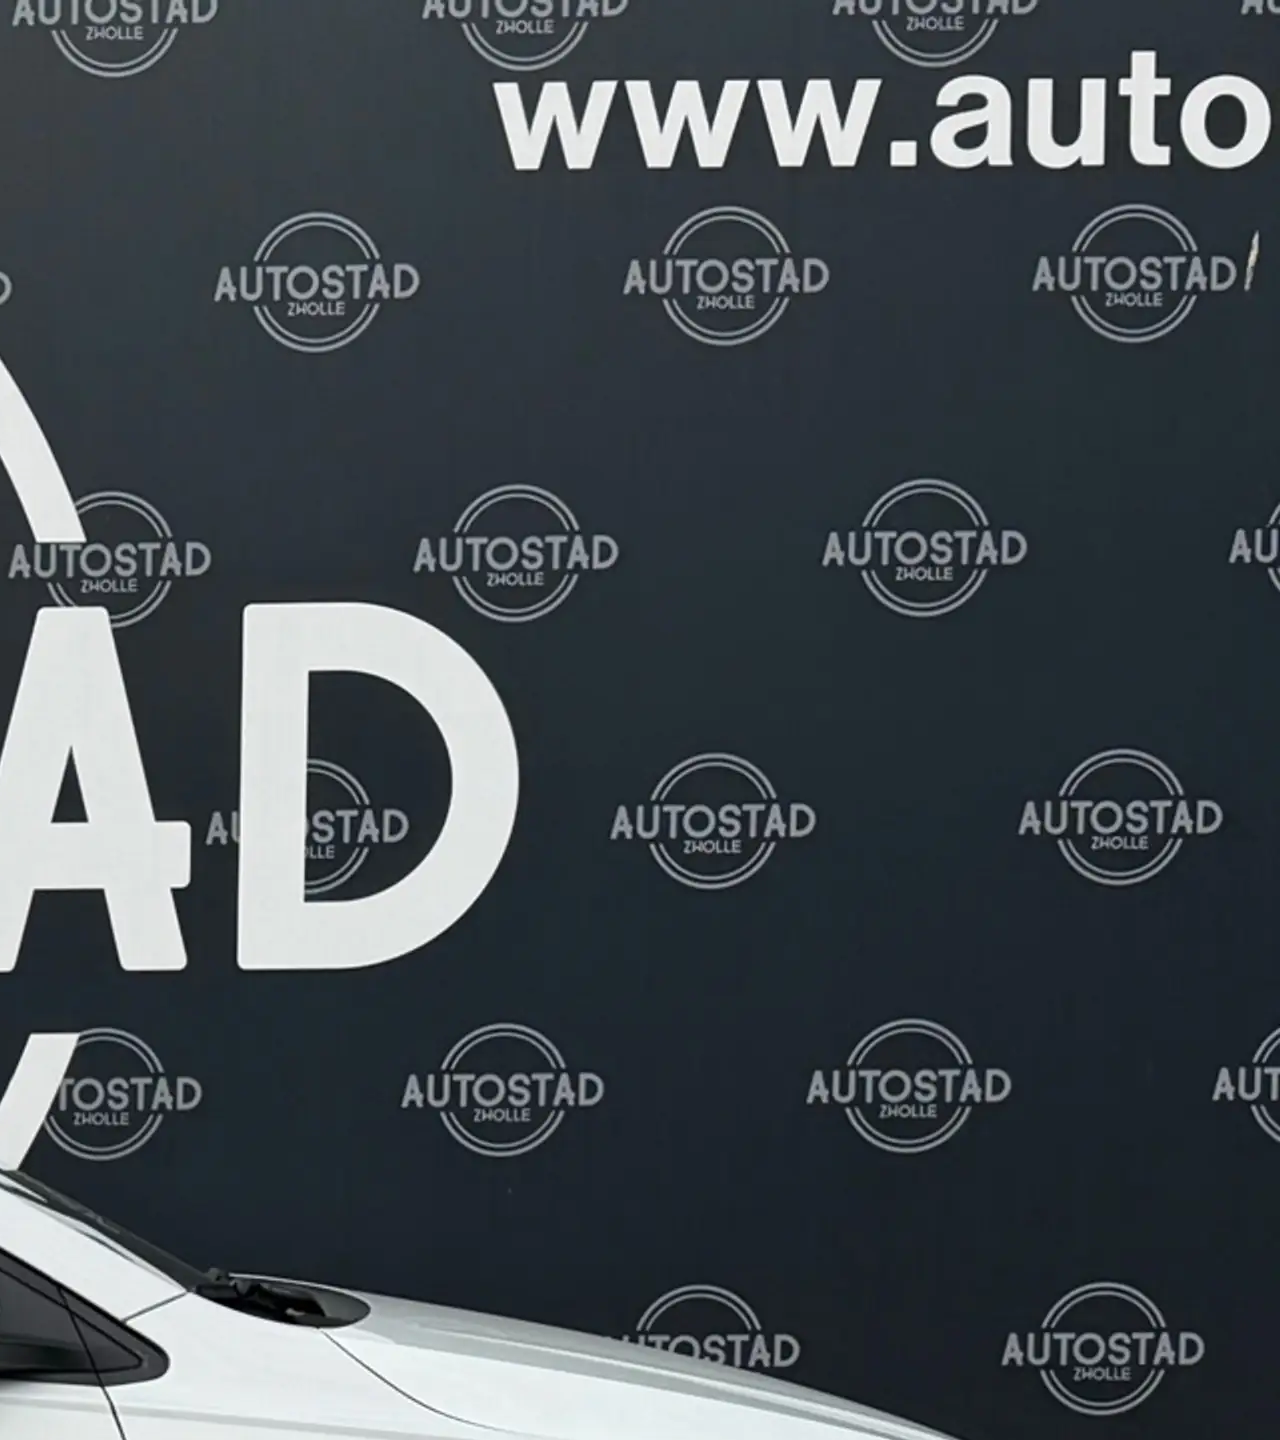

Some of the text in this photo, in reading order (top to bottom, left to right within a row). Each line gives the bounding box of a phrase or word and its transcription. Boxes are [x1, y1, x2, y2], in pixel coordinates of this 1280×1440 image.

[493, 50, 1272, 169] www.auto
[213, 264, 421, 300] AUTOSTAD
[622, 258, 830, 294] AUTOSTAD
[1033, 256, 1239, 292] AUTOSTAD
[8, 543, 214, 579] AUTOSTAD
[412, 535, 620, 571] AUTOSTAD
[823, 530, 1029, 566] AUTOSTAD
[609, 803, 817, 839] AUTOSTAD
[1019, 799, 1225, 835] AUTOSTAD
[401, 1072, 605, 1107] AUTOSTAD
[807, 1068, 1011, 1103] AUTOSTAD
[1001, 1331, 1205, 1366] AUTOSTAD
